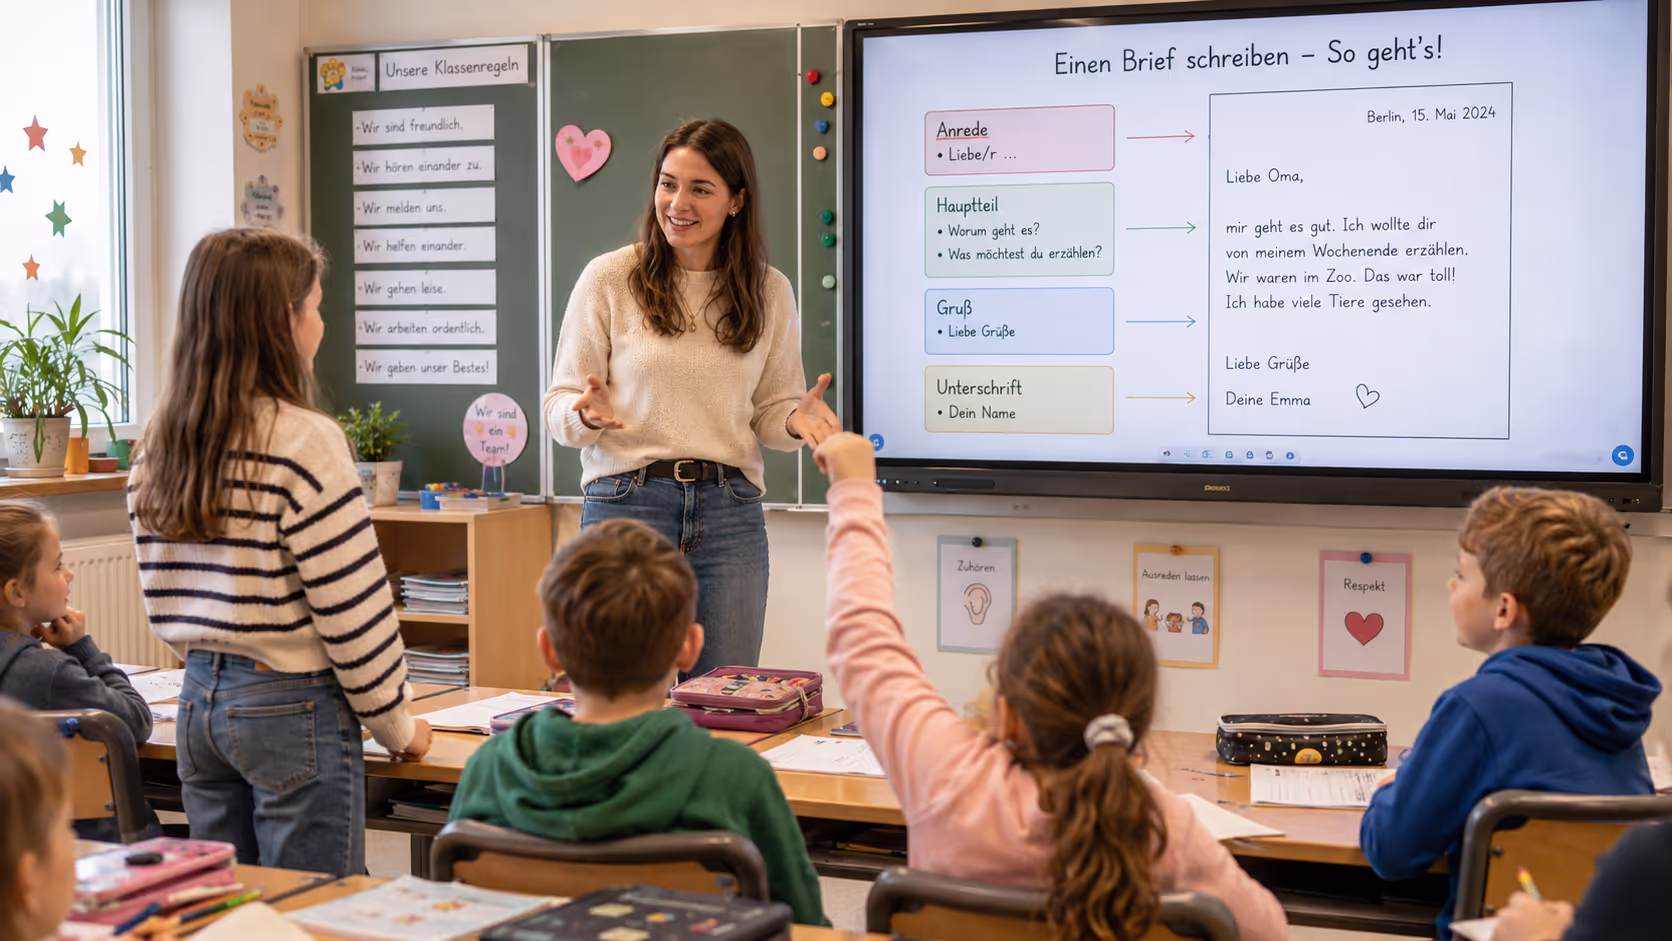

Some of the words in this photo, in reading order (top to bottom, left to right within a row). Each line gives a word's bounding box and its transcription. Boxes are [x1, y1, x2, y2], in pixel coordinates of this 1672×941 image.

[1056, 52, 1110, 74] Einen
[1124, 47, 1176, 71] Brief
[1187, 43, 1288, 69] schreiben
[1328, 40, 1355, 63] So
[386, 63, 428, 77] Unsere
[435, 56, 518, 77] Klassenregeln
[1368, 110, 1404, 123] Berlin,
[1412, 109, 1428, 121] 15.
[1436, 108, 1455, 120] Mai
[1463, 106, 1496, 119] 2024
[385, 120, 405, 133] sind
[937, 121, 987, 137] Anrede
[949, 146, 996, 161] Liebe/r
[386, 160, 413, 173] hören
[418, 159, 461, 172] einander
[1227, 169, 1260, 183] Liebe
[1268, 168, 1303, 183] Oma,
[386, 201, 420, 213] melden
[937, 196, 998, 217] Hauptteil
[948, 224, 986, 236] Worum
[992, 223, 1015, 240] geht
[1021, 222, 1039, 235] es?
[1227, 222, 1247, 233] mir
[1255, 219, 1282, 238] geht
[1290, 223, 1303, 233] es
[1311, 219, 1334, 237] gut.
[1343, 217, 1363, 231] Ich
[1371, 217, 1410, 230] wollte
[1418, 216, 1436, 230] dir
[387, 239, 416, 252] helfen
[421, 239, 465, 251] einander.
[948, 248, 971, 260] Was
[977, 248, 1024, 259] möchtest
[1031, 246, 1043, 259] du
[1049, 245, 1102, 258] erzählen?
[1226, 249, 1248, 259] von
[1256, 247, 1305, 258] meinem
[1313, 243, 1397, 257] Wochenende
[1406, 242, 1468, 256] erzählen.
[1226, 270, 1249, 283] Wir
[1257, 274, 1296, 284] waren
[1304, 271, 1318, 282] im
[1326, 269, 1355, 282] Zoo.
[1365, 268, 1390, 282] Das
[1397, 273, 1422, 282] war
[1430, 267, 1455, 281] toll!
[387, 282, 416, 298] gehen
[937, 299, 972, 319] Gruß
[1226, 295, 1246, 308] Ich
[1254, 295, 1284, 308] habe
[1292, 294, 1321, 308] viele
[1329, 294, 1364, 307] Tiere
[1372, 294, 1430, 313] gesehen.
[387, 321, 427, 333] arbeiten
[432, 321, 484, 334] ordentlich.
[949, 325, 976, 337] Liebe
[982, 324, 1015, 339] Grüße
[387, 361, 415, 377] geben
[421, 364, 447, 374] unser
[453, 360, 489, 373] Bestes!
[1226, 356, 1260, 369] Liebe
[1268, 356, 1309, 373] Grüße
[937, 379, 1022, 395] Unterschrift
[1226, 391, 1262, 405] Deine
[1271, 392, 1311, 406] Emma
[476, 405, 492, 418] Wir
[497, 408, 517, 420] sind
[950, 405, 975, 418] Dein
[982, 406, 1015, 419] Name
[489, 426, 503, 436] ein
[480, 440, 509, 454] Team!
[1344, 578, 1385, 594] Respekt
